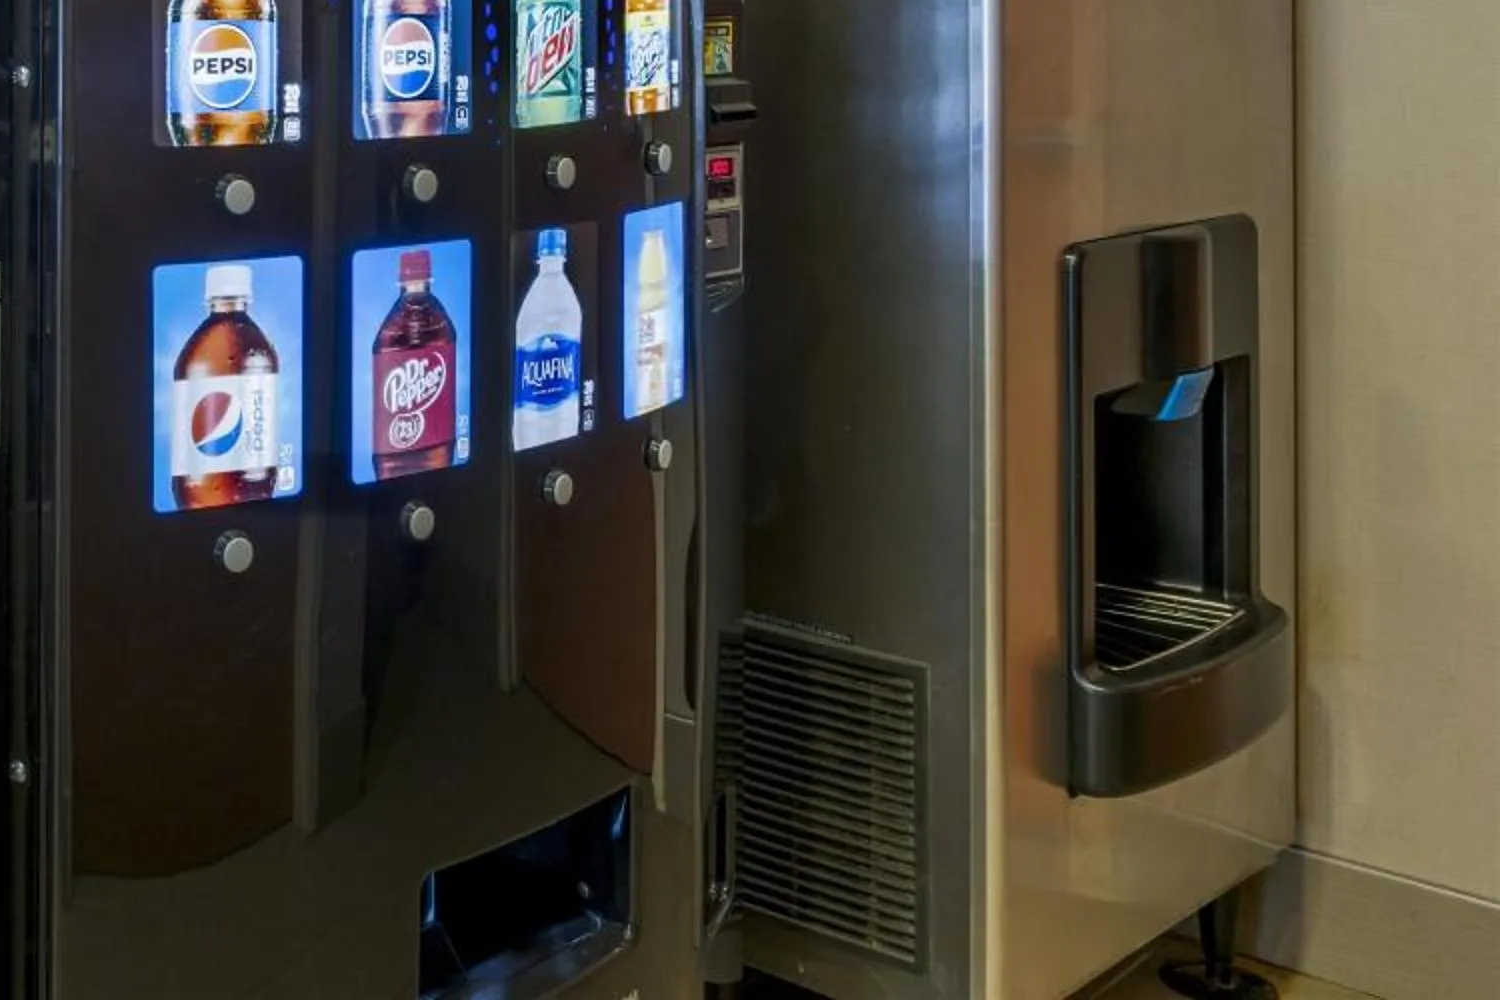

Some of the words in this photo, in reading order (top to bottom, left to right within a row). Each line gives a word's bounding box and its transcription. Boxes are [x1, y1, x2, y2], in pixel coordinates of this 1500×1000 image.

[193, 56, 254, 75] PEPSI
[383, 50, 432, 66] PEPSI
[406, 357, 429, 382] Dr
[521, 354, 575, 390] AQUAFINA
[389, 365, 444, 414] Pepper
[252, 391, 264, 452] pepsi
